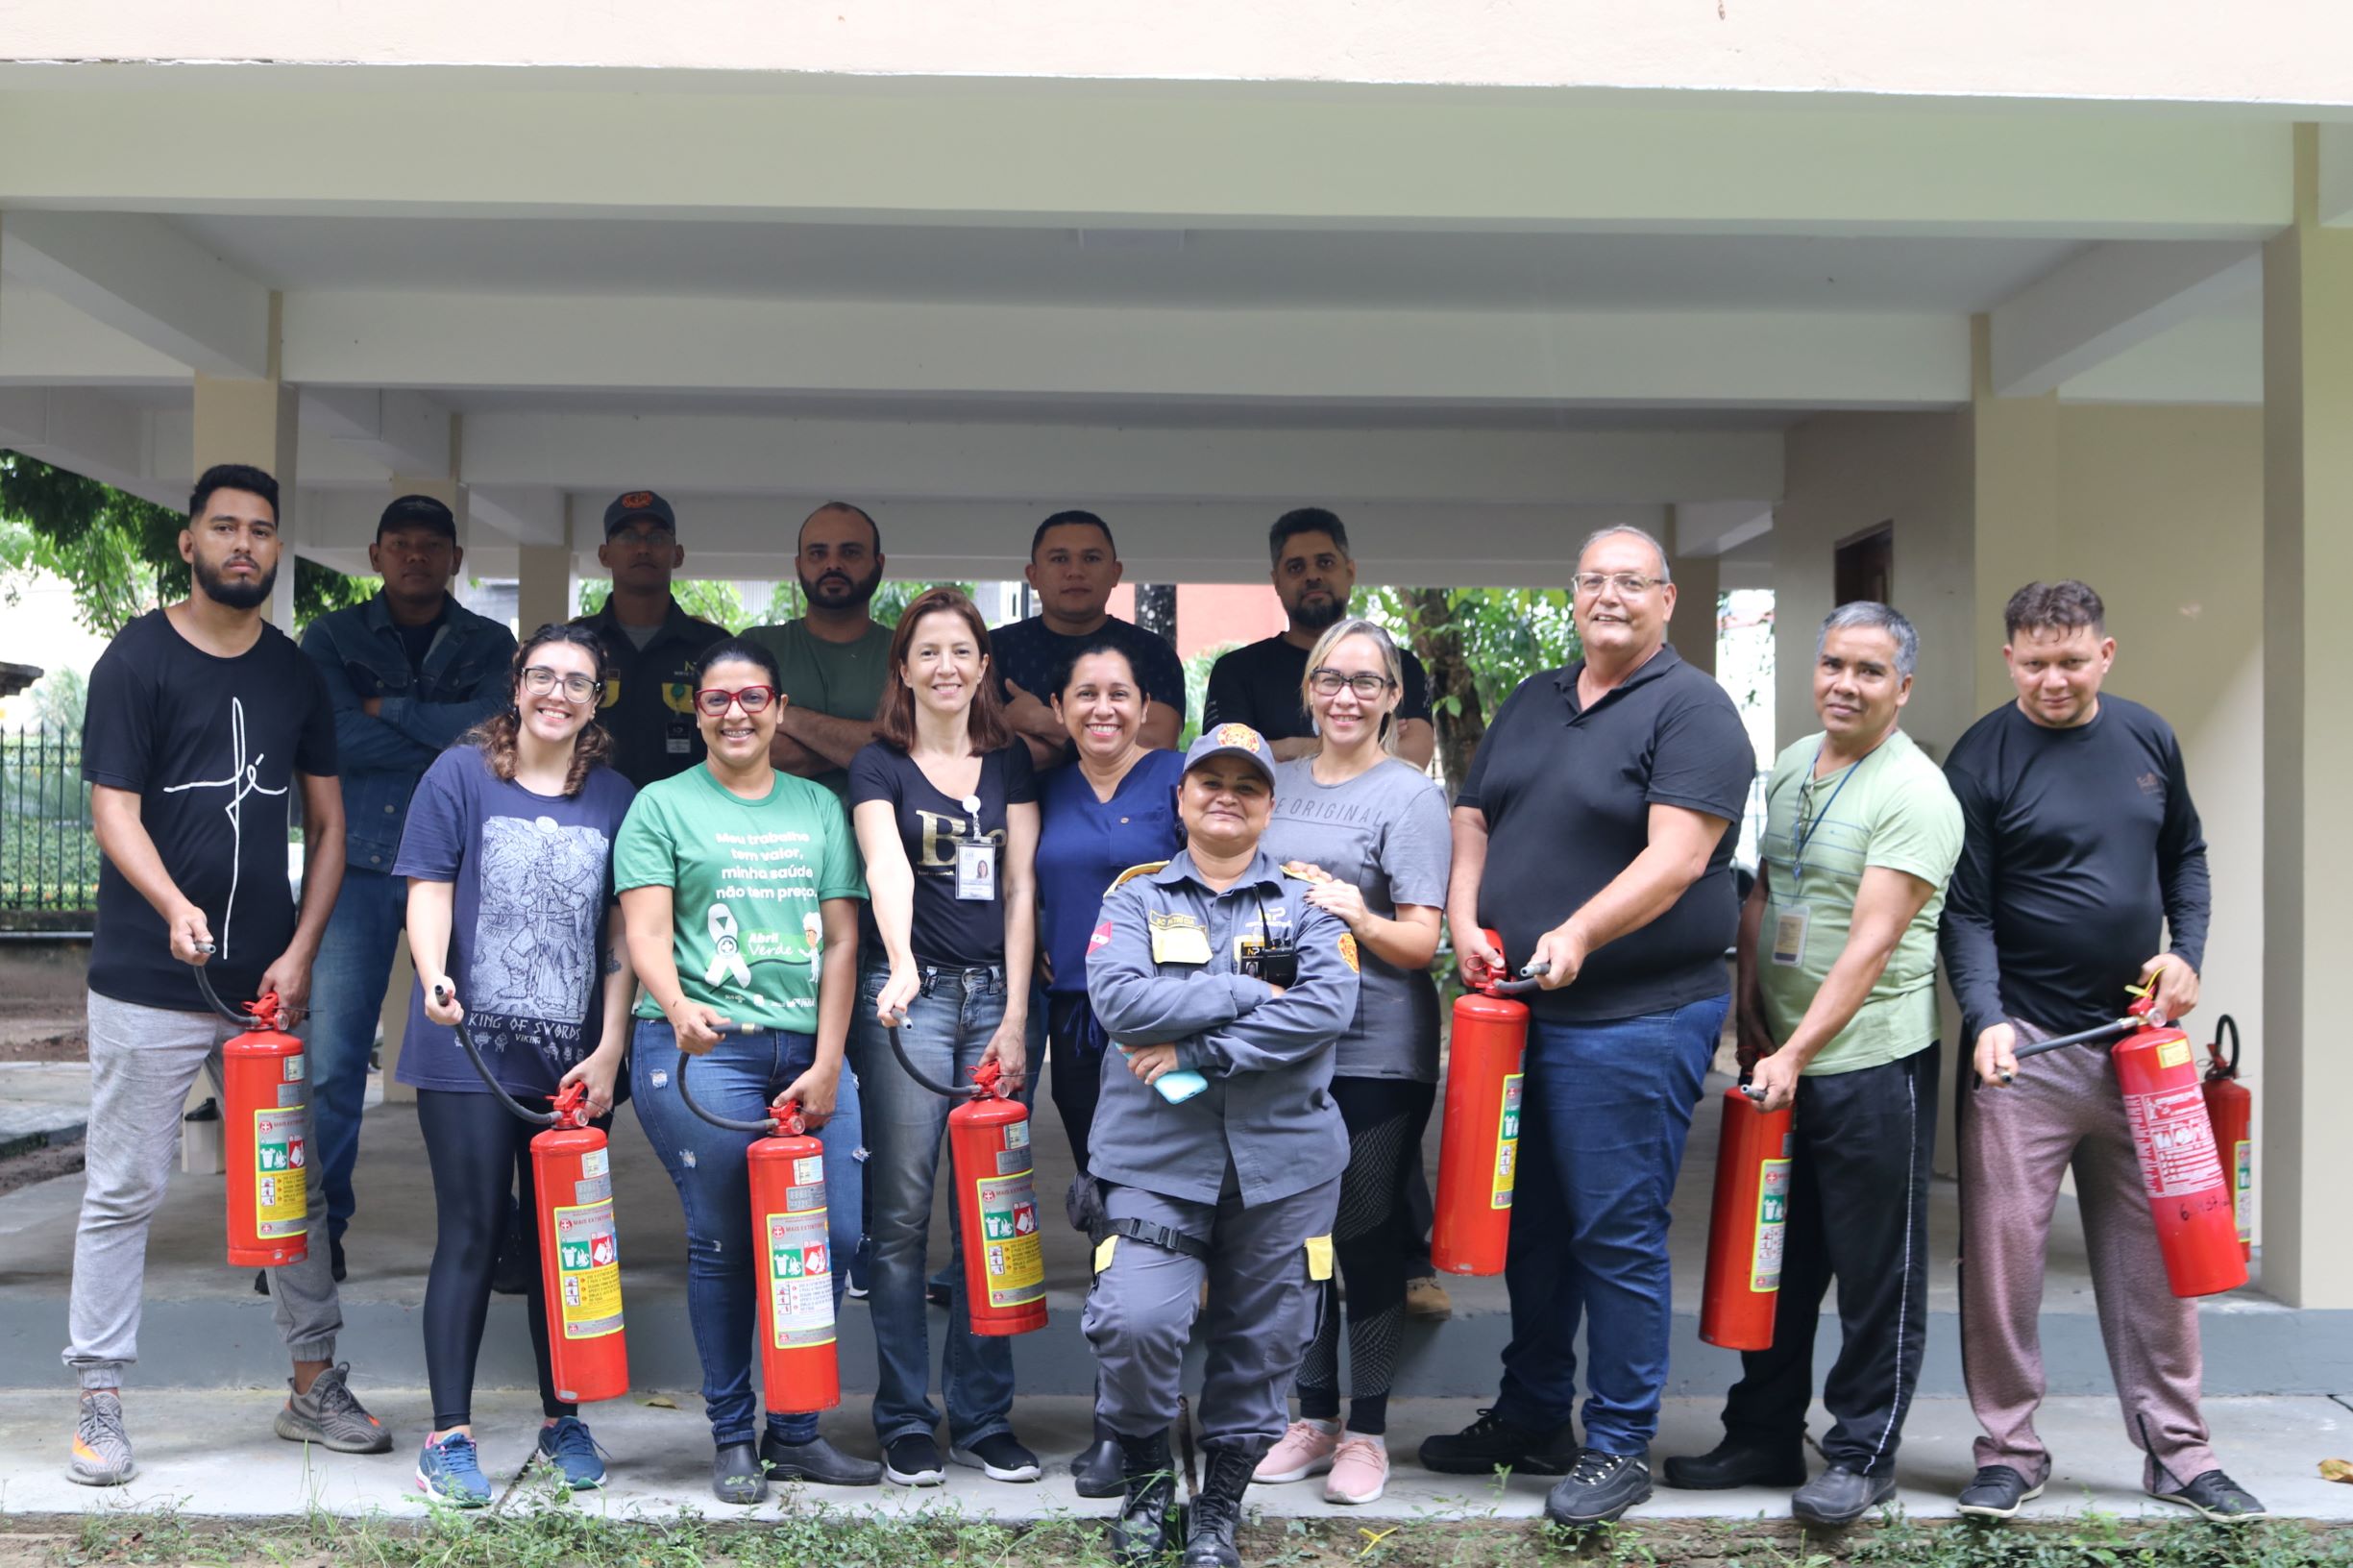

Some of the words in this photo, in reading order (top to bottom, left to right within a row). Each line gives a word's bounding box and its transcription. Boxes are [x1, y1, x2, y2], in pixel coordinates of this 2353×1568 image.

[1289, 797, 1383, 827] ORIGINAL
[715, 832, 747, 845] Meu
[748, 831, 810, 845] trabalho
[730, 847, 759, 862] tem
[759, 846, 804, 862] valor,
[721, 865, 769, 880] minha
[769, 863, 814, 879] saúde
[715, 885, 746, 899] não
[747, 886, 775, 899] tem
[776, 886, 818, 902] preço.
[748, 931, 779, 943] Abril
[748, 943, 794, 956] Verde
[467, 1012, 503, 1029] KING
[509, 1017, 529, 1032] OF
[533, 1019, 582, 1041] SWORDS
[514, 1033, 542, 1045] VIKING
